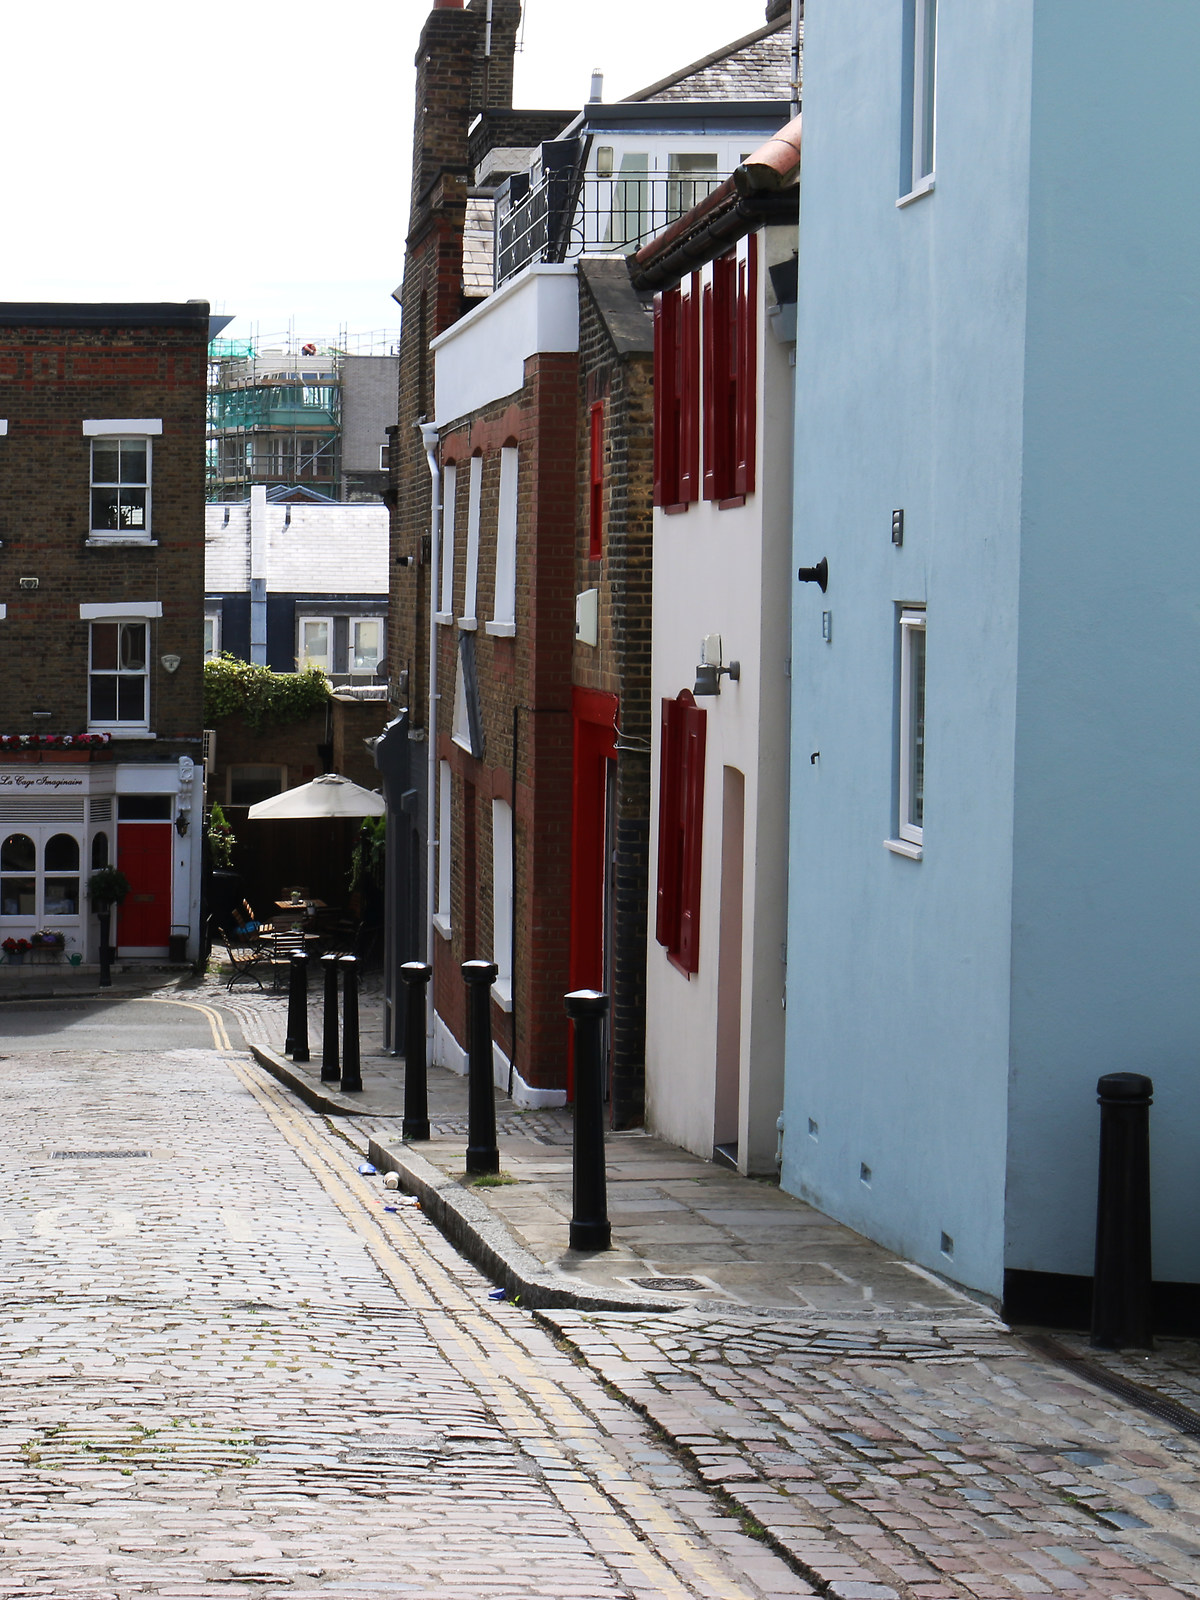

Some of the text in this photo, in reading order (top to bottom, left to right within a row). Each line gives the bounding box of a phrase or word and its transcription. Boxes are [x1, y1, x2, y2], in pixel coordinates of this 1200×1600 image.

[0, 775, 12, 785] La
[14, 775, 34, 788] Cage
[36, 776, 83, 788] Imaginaire
